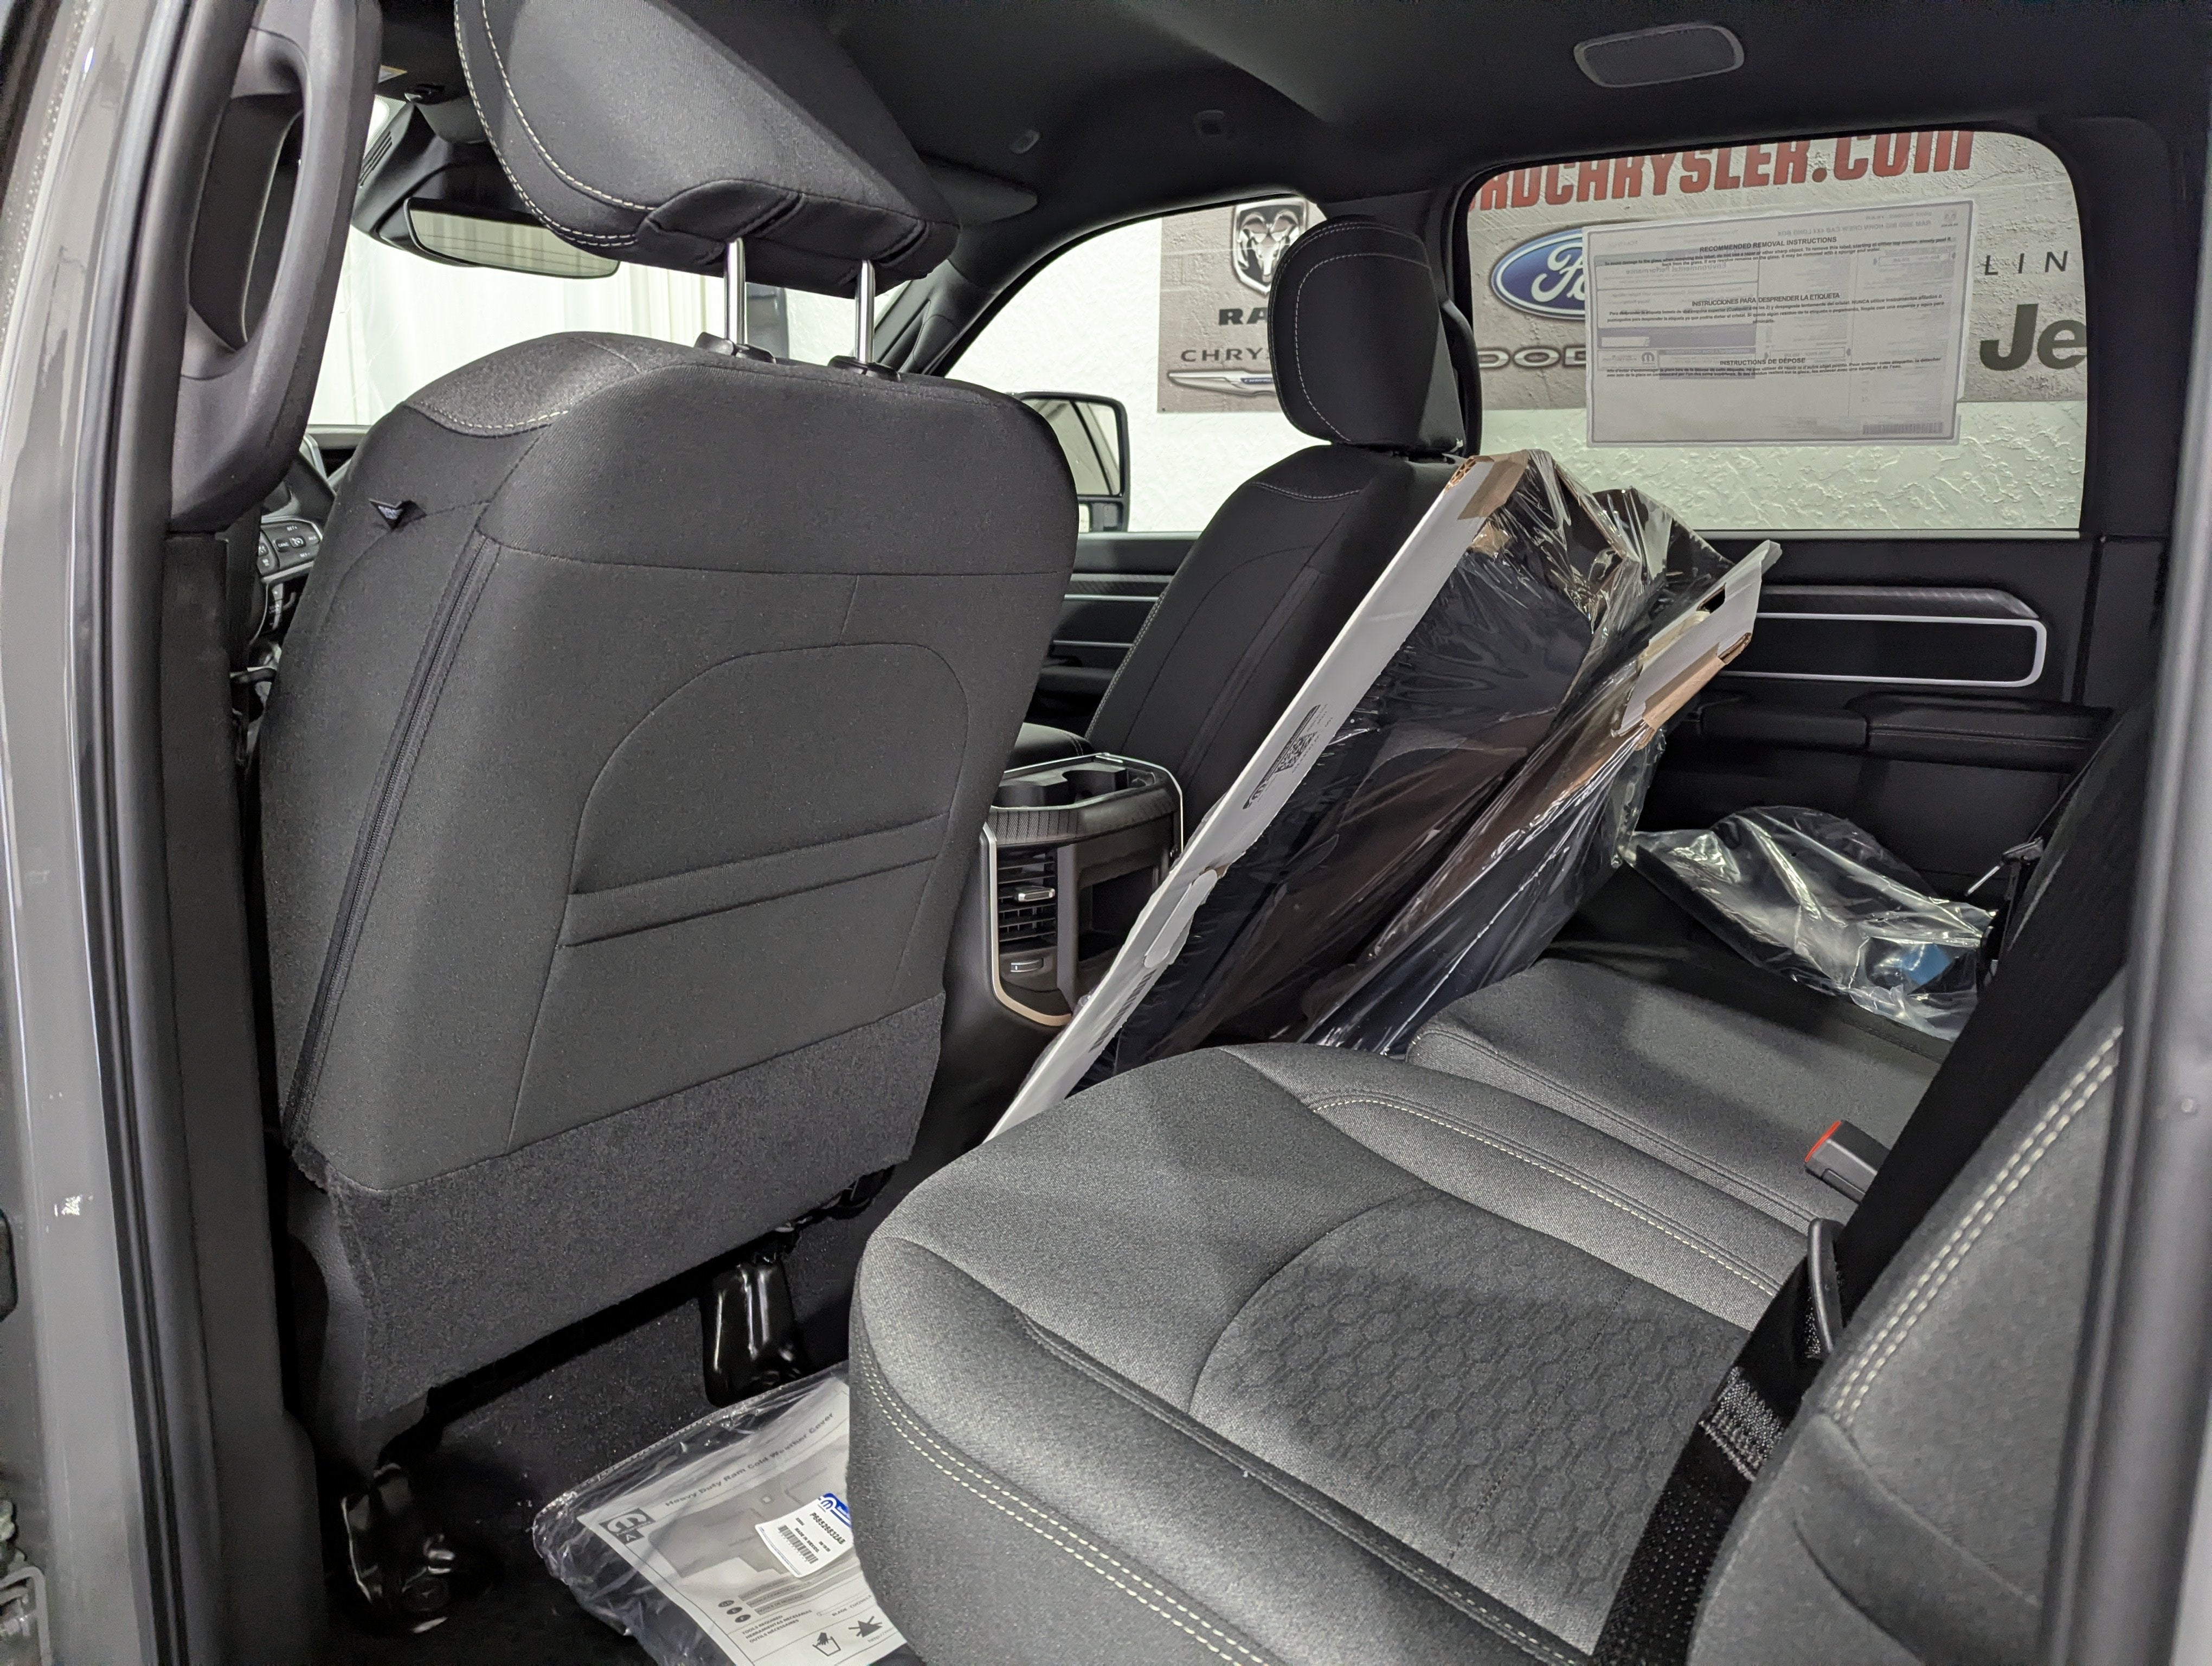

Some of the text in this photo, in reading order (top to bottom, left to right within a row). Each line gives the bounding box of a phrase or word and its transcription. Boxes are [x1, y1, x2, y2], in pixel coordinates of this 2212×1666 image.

[1468, 130, 1974, 212] RDCHRYSLER.COM
[1699, 236, 1837, 252] RECOMMENDED REMOVAL INSTRUCTIONS
[1692, 298, 1739, 306] INSTRUCCIONES
[1980, 303, 2087, 371] Je
[1181, 347, 1269, 362] CHRY
[665, 1412, 834, 1507] Heavy Duty Ram Cold Weather Cover
[742, 1615, 783, 1635] TOOLS REQUIRED
[749, 1632, 768, 1643] OUTILS
